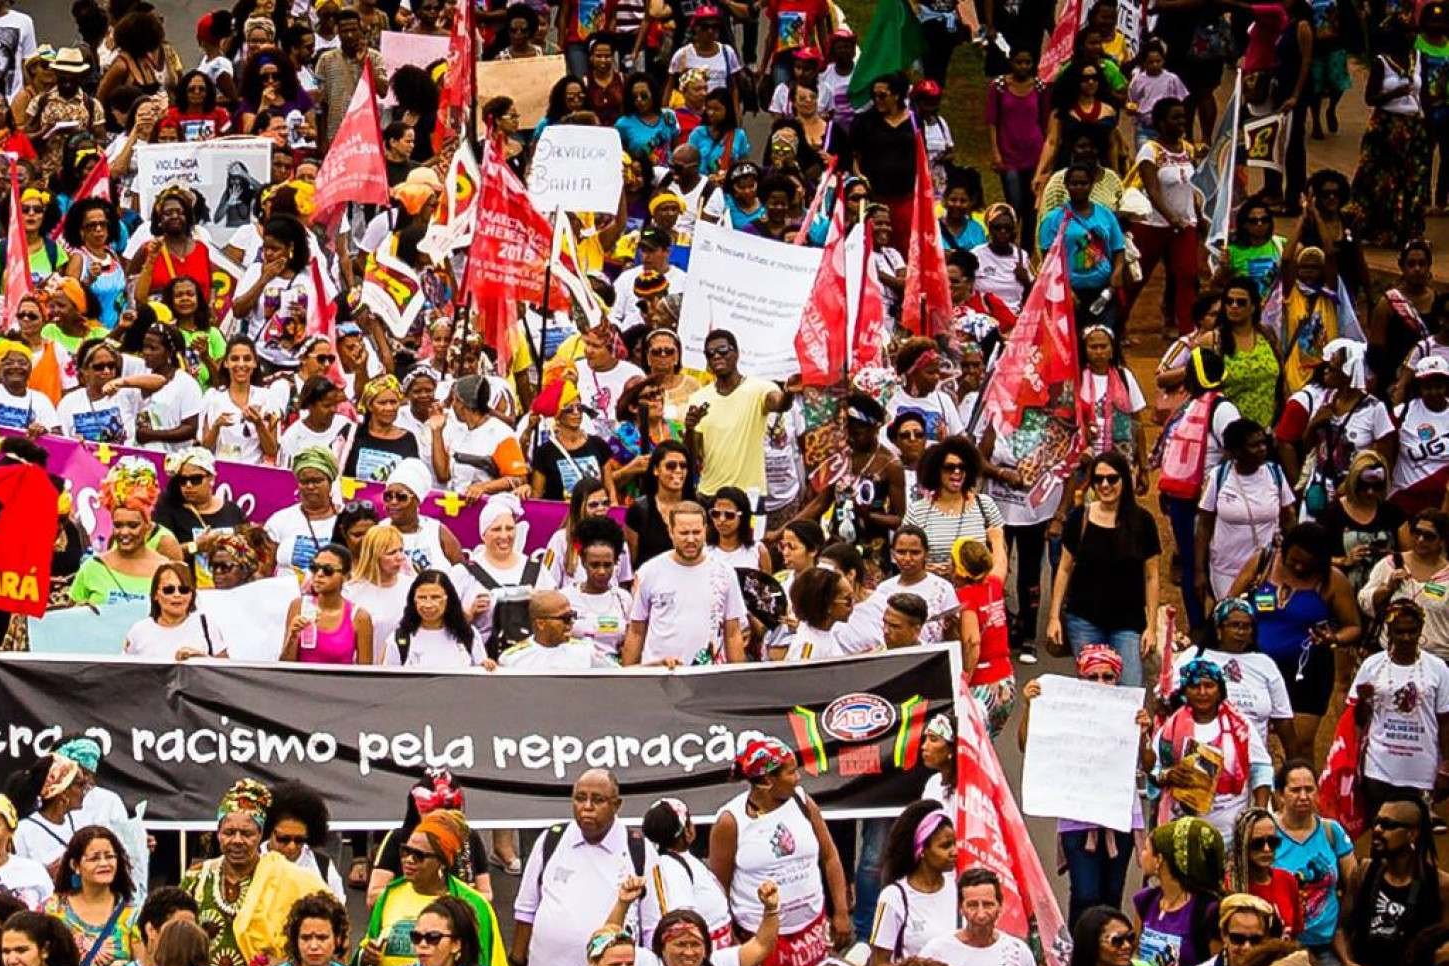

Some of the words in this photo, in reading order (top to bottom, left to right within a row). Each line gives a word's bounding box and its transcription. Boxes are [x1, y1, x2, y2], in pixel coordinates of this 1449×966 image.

[529, 165, 591, 195] BAHIA
[131, 715, 337, 765] racismo
[358, 725, 473, 776] pela
